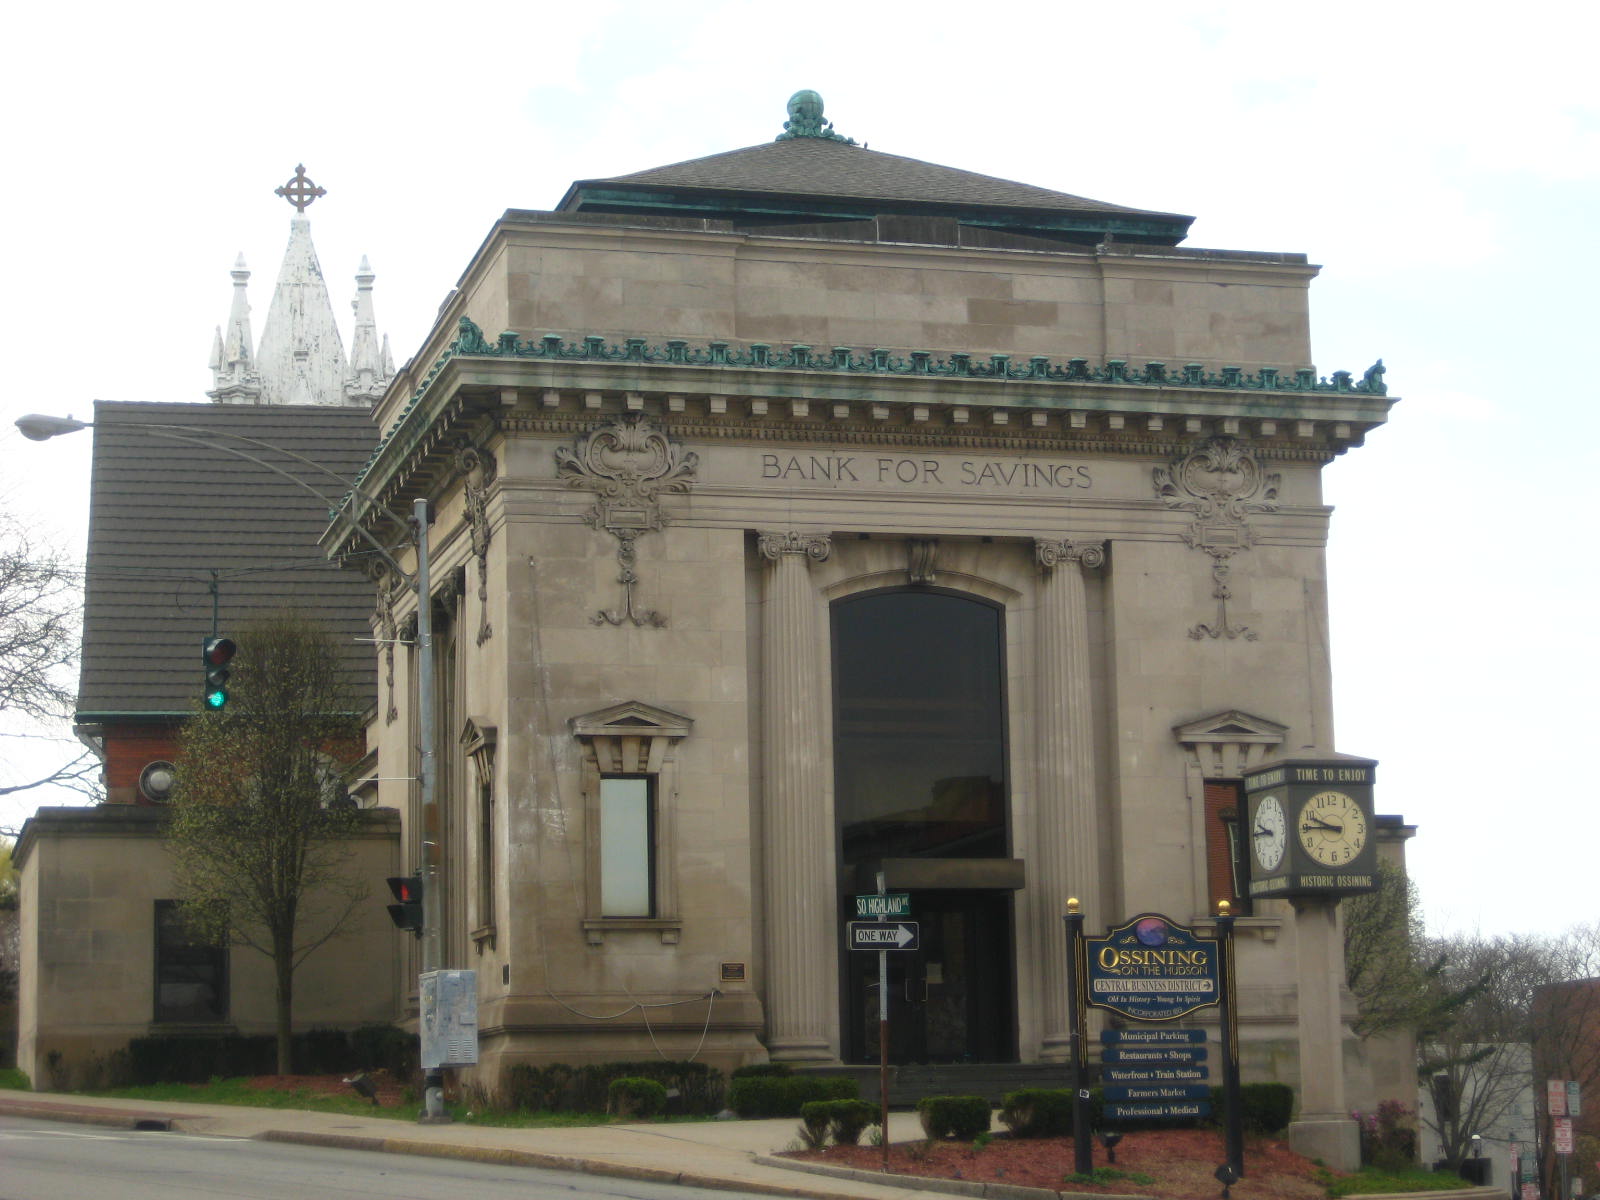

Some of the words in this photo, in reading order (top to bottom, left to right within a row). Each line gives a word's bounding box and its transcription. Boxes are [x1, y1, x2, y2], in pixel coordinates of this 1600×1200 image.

[761, 454, 859, 482] BANK
[877, 458, 943, 484] FOR
[961, 461, 1092, 489] SAVINGS
[1296, 768, 1318, 781] TIME
[1324, 769, 1334, 781] TO
[1339, 769, 1366, 781] ENJOY
[1316, 798, 1324, 808] 11
[1327, 795, 1336, 806] 12
[1342, 798, 1346, 808] 1
[1352, 809, 1359, 819] 2
[1358, 824, 1364, 834] 3
[1307, 838, 1313, 848] 8
[1354, 838, 1360, 848] 4
[1318, 848, 1324, 858] 7
[1331, 852, 1337, 861] 6
[1344, 848, 1350, 858] 5
[1300, 876, 1334, 886] HISTORIC
[1338, 876, 1372, 886] OSSINING
[869, 897, 901, 913] HIGHLAND
[858, 931, 876, 941] ONE
[879, 931, 897, 940] WAY
[1099, 946, 1207, 973] OSSINING
[1121, 967, 1138, 976] ON
[1143, 967, 1160, 975] THE
[1165, 966, 1207, 975] HUDSON
[1095, 981, 1130, 991] CENTRAL
[1132, 980, 1167, 991] BUSINESS
[1168, 980, 1201, 991] DISTRICT
[1129, 996, 1151, 1004] History
[1185, 995, 1201, 1004] Spirit
[1120, 1032, 1158, 1041] Municipal
[1161, 1032, 1189, 1041] Parking
[1169, 1051, 1191, 1061] Shops
[1111, 1071, 1148, 1079] Waterfront
[1156, 1071, 1174, 1079] Train
[1176, 1070, 1201, 1078] Station
[1128, 1089, 1158, 1097] Farmers
[1161, 1089, 1186, 1097] Market
[1117, 1107, 1163, 1116] Professional
[1170, 1106, 1199, 1115] Medical
